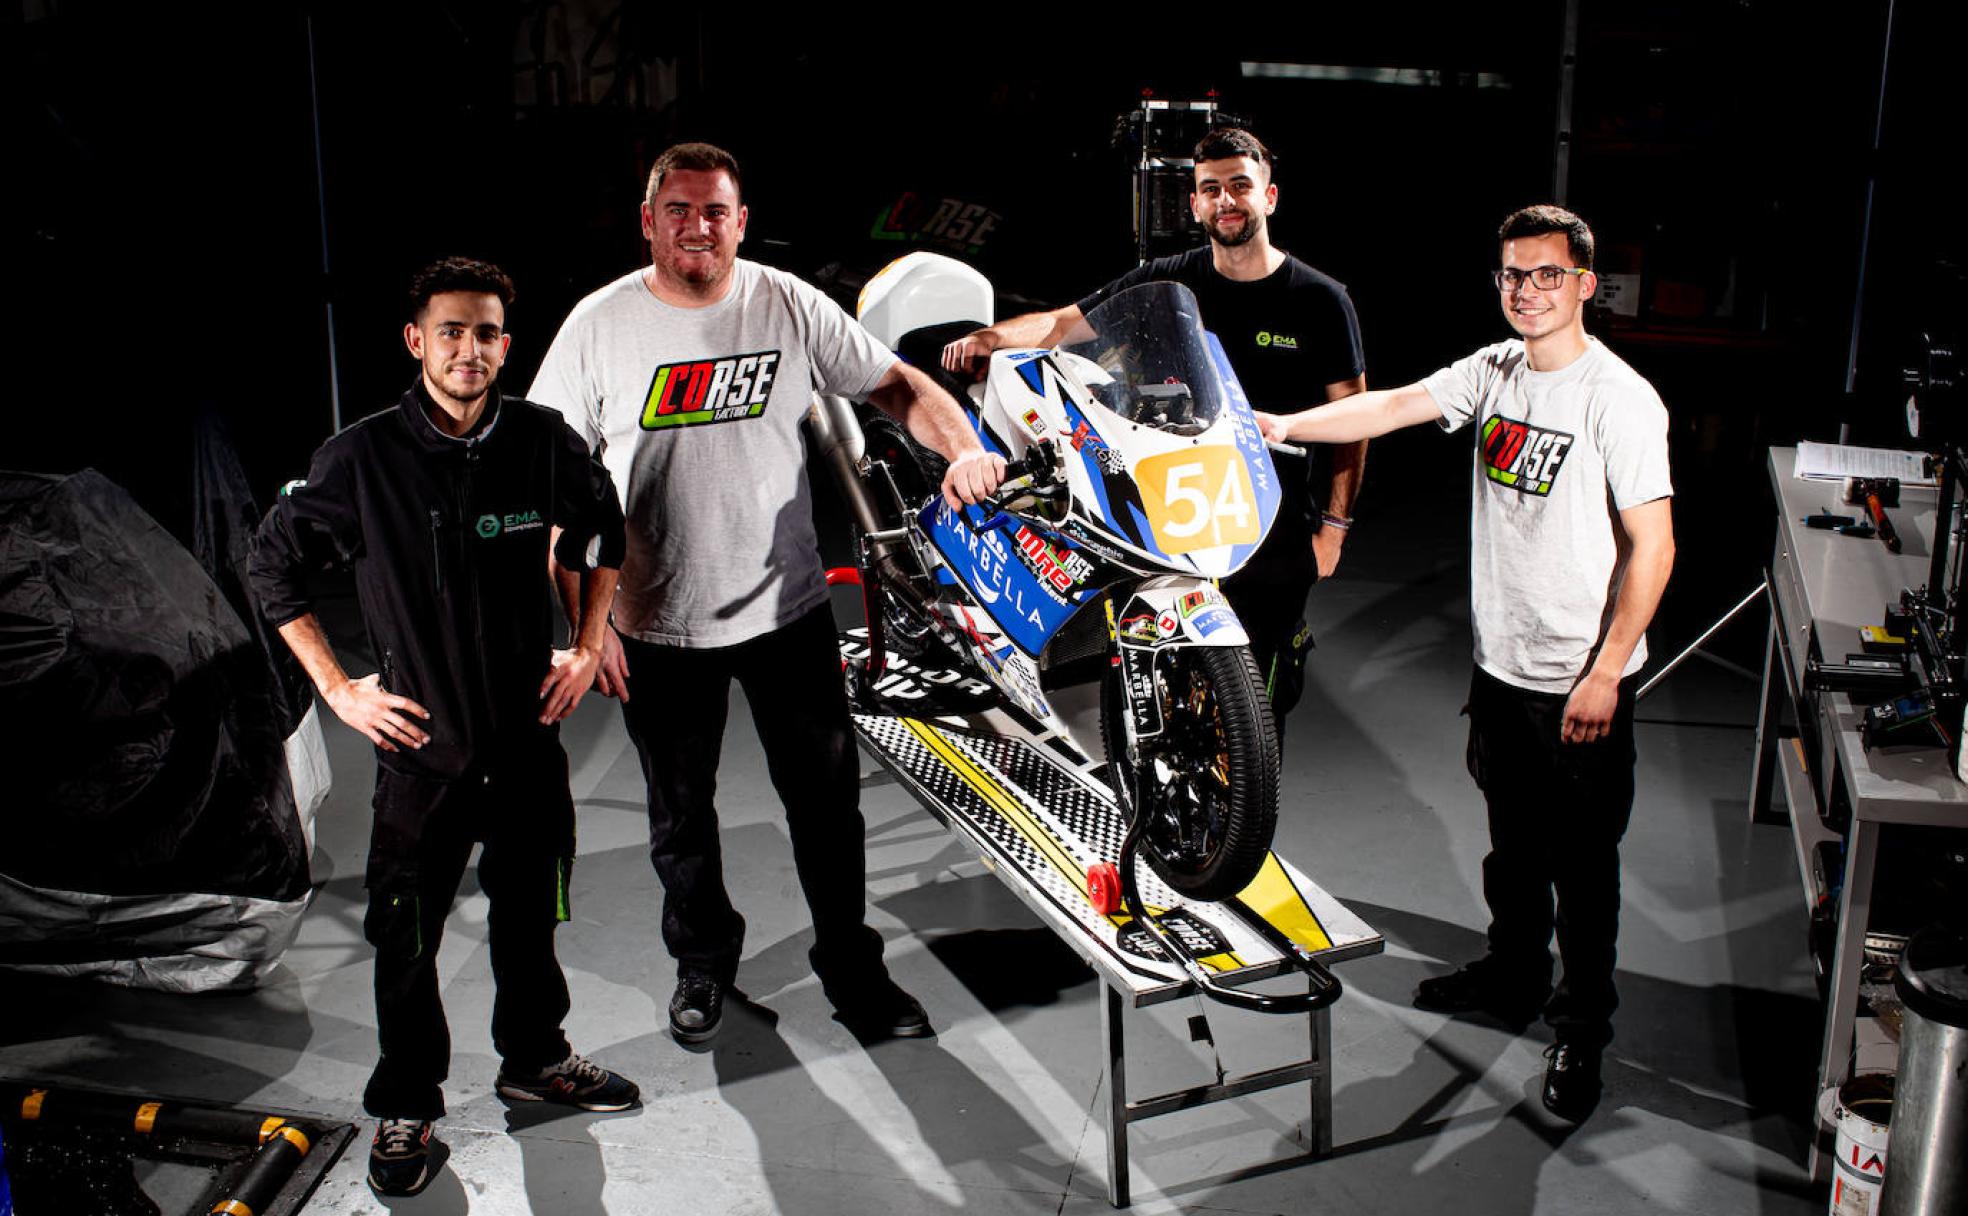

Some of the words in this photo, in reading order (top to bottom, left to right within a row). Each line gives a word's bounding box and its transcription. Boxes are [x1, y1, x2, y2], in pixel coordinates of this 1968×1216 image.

[658, 353, 777, 415] CORSE
[1483, 420, 1572, 482] CORSE
[503, 510, 540, 527] EMA
[1162, 457, 1251, 538] 54
[936, 498, 1045, 633] MARBELLA
[1128, 650, 1149, 726] MARBELLA
